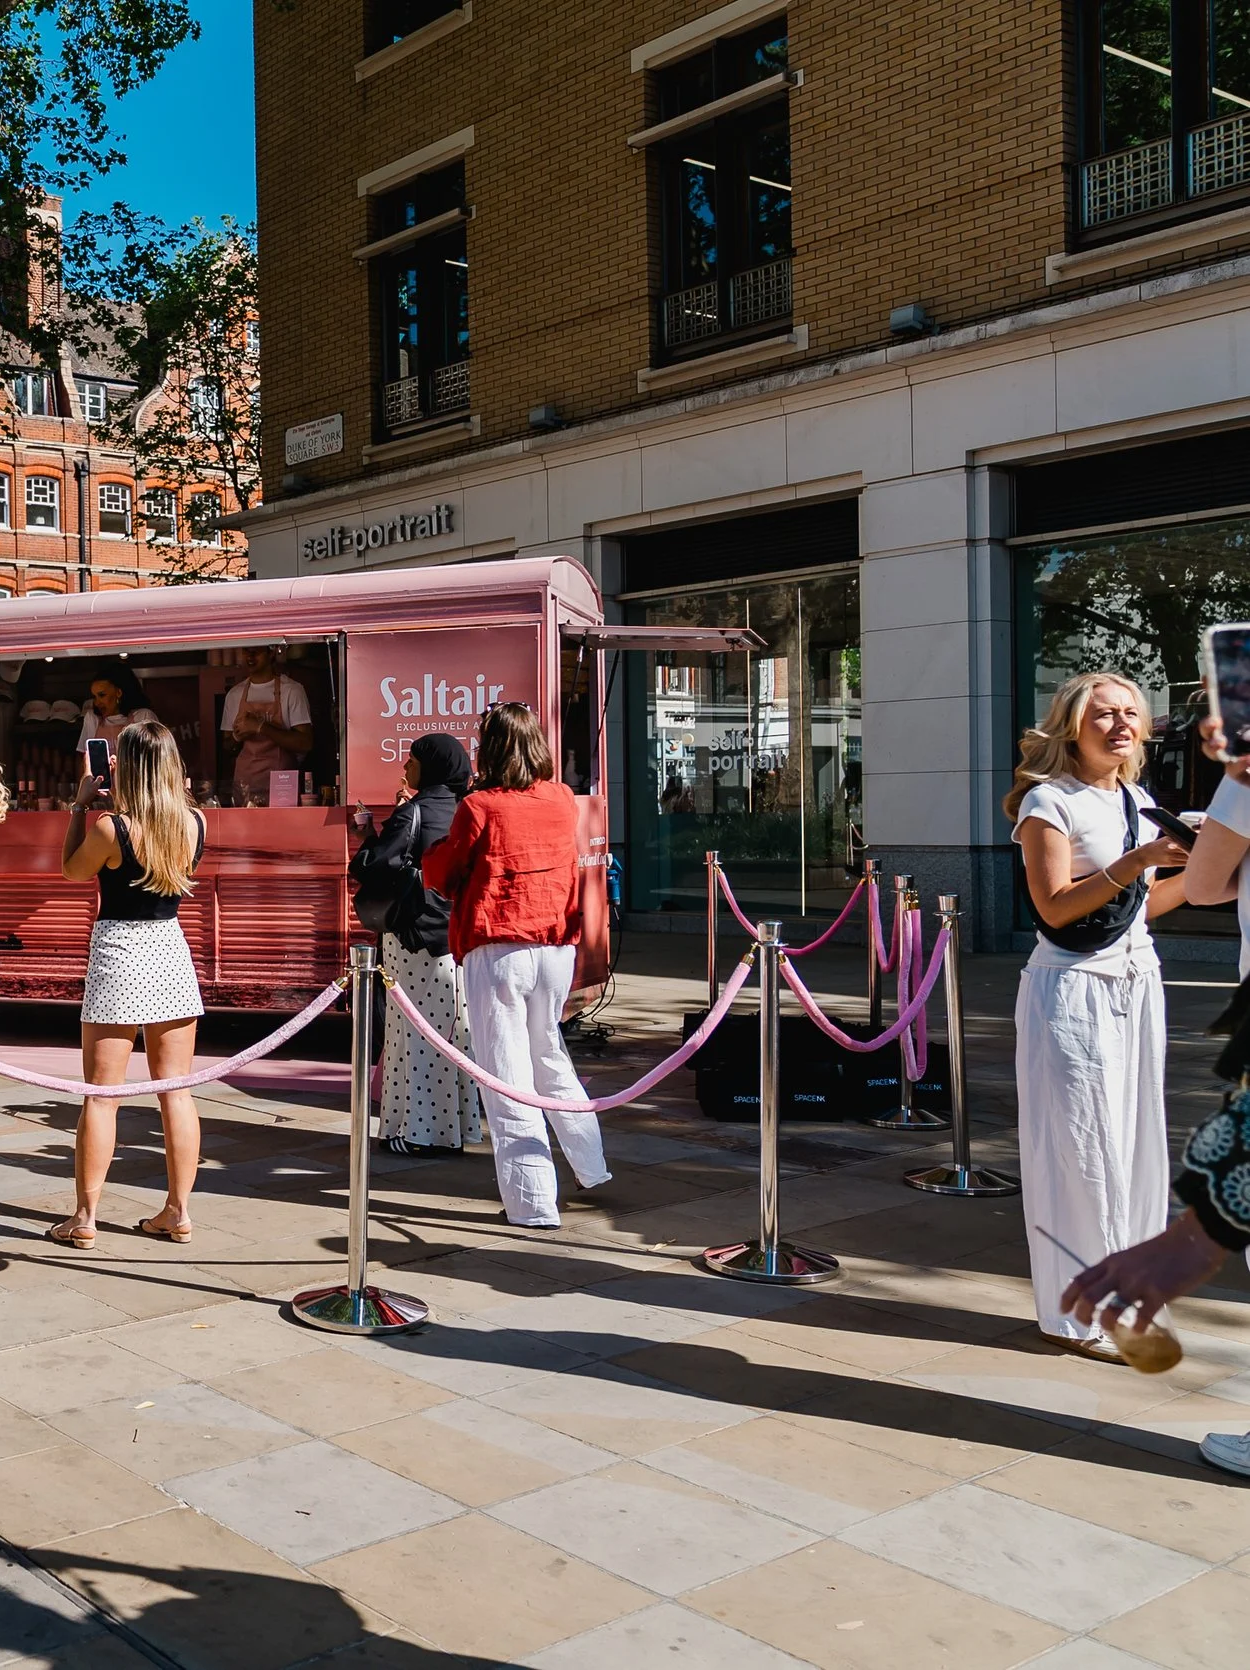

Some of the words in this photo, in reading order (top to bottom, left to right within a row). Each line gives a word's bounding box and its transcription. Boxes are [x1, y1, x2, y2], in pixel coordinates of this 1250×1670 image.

[287, 440, 306, 454] DUKE
[308, 437, 318, 448] OF
[320, 430, 341, 444] YORK
[289, 447, 318, 463] SQUARE
[302, 505, 450, 561] self-portrait
[380, 674, 504, 718] Saltair
[396, 721, 469, 732] EXCLUSIVELY
[708, 748, 784, 774] portrait
[915, 1083, 942, 1091] PACENK
[733, 1095, 762, 1104] SPACEN
